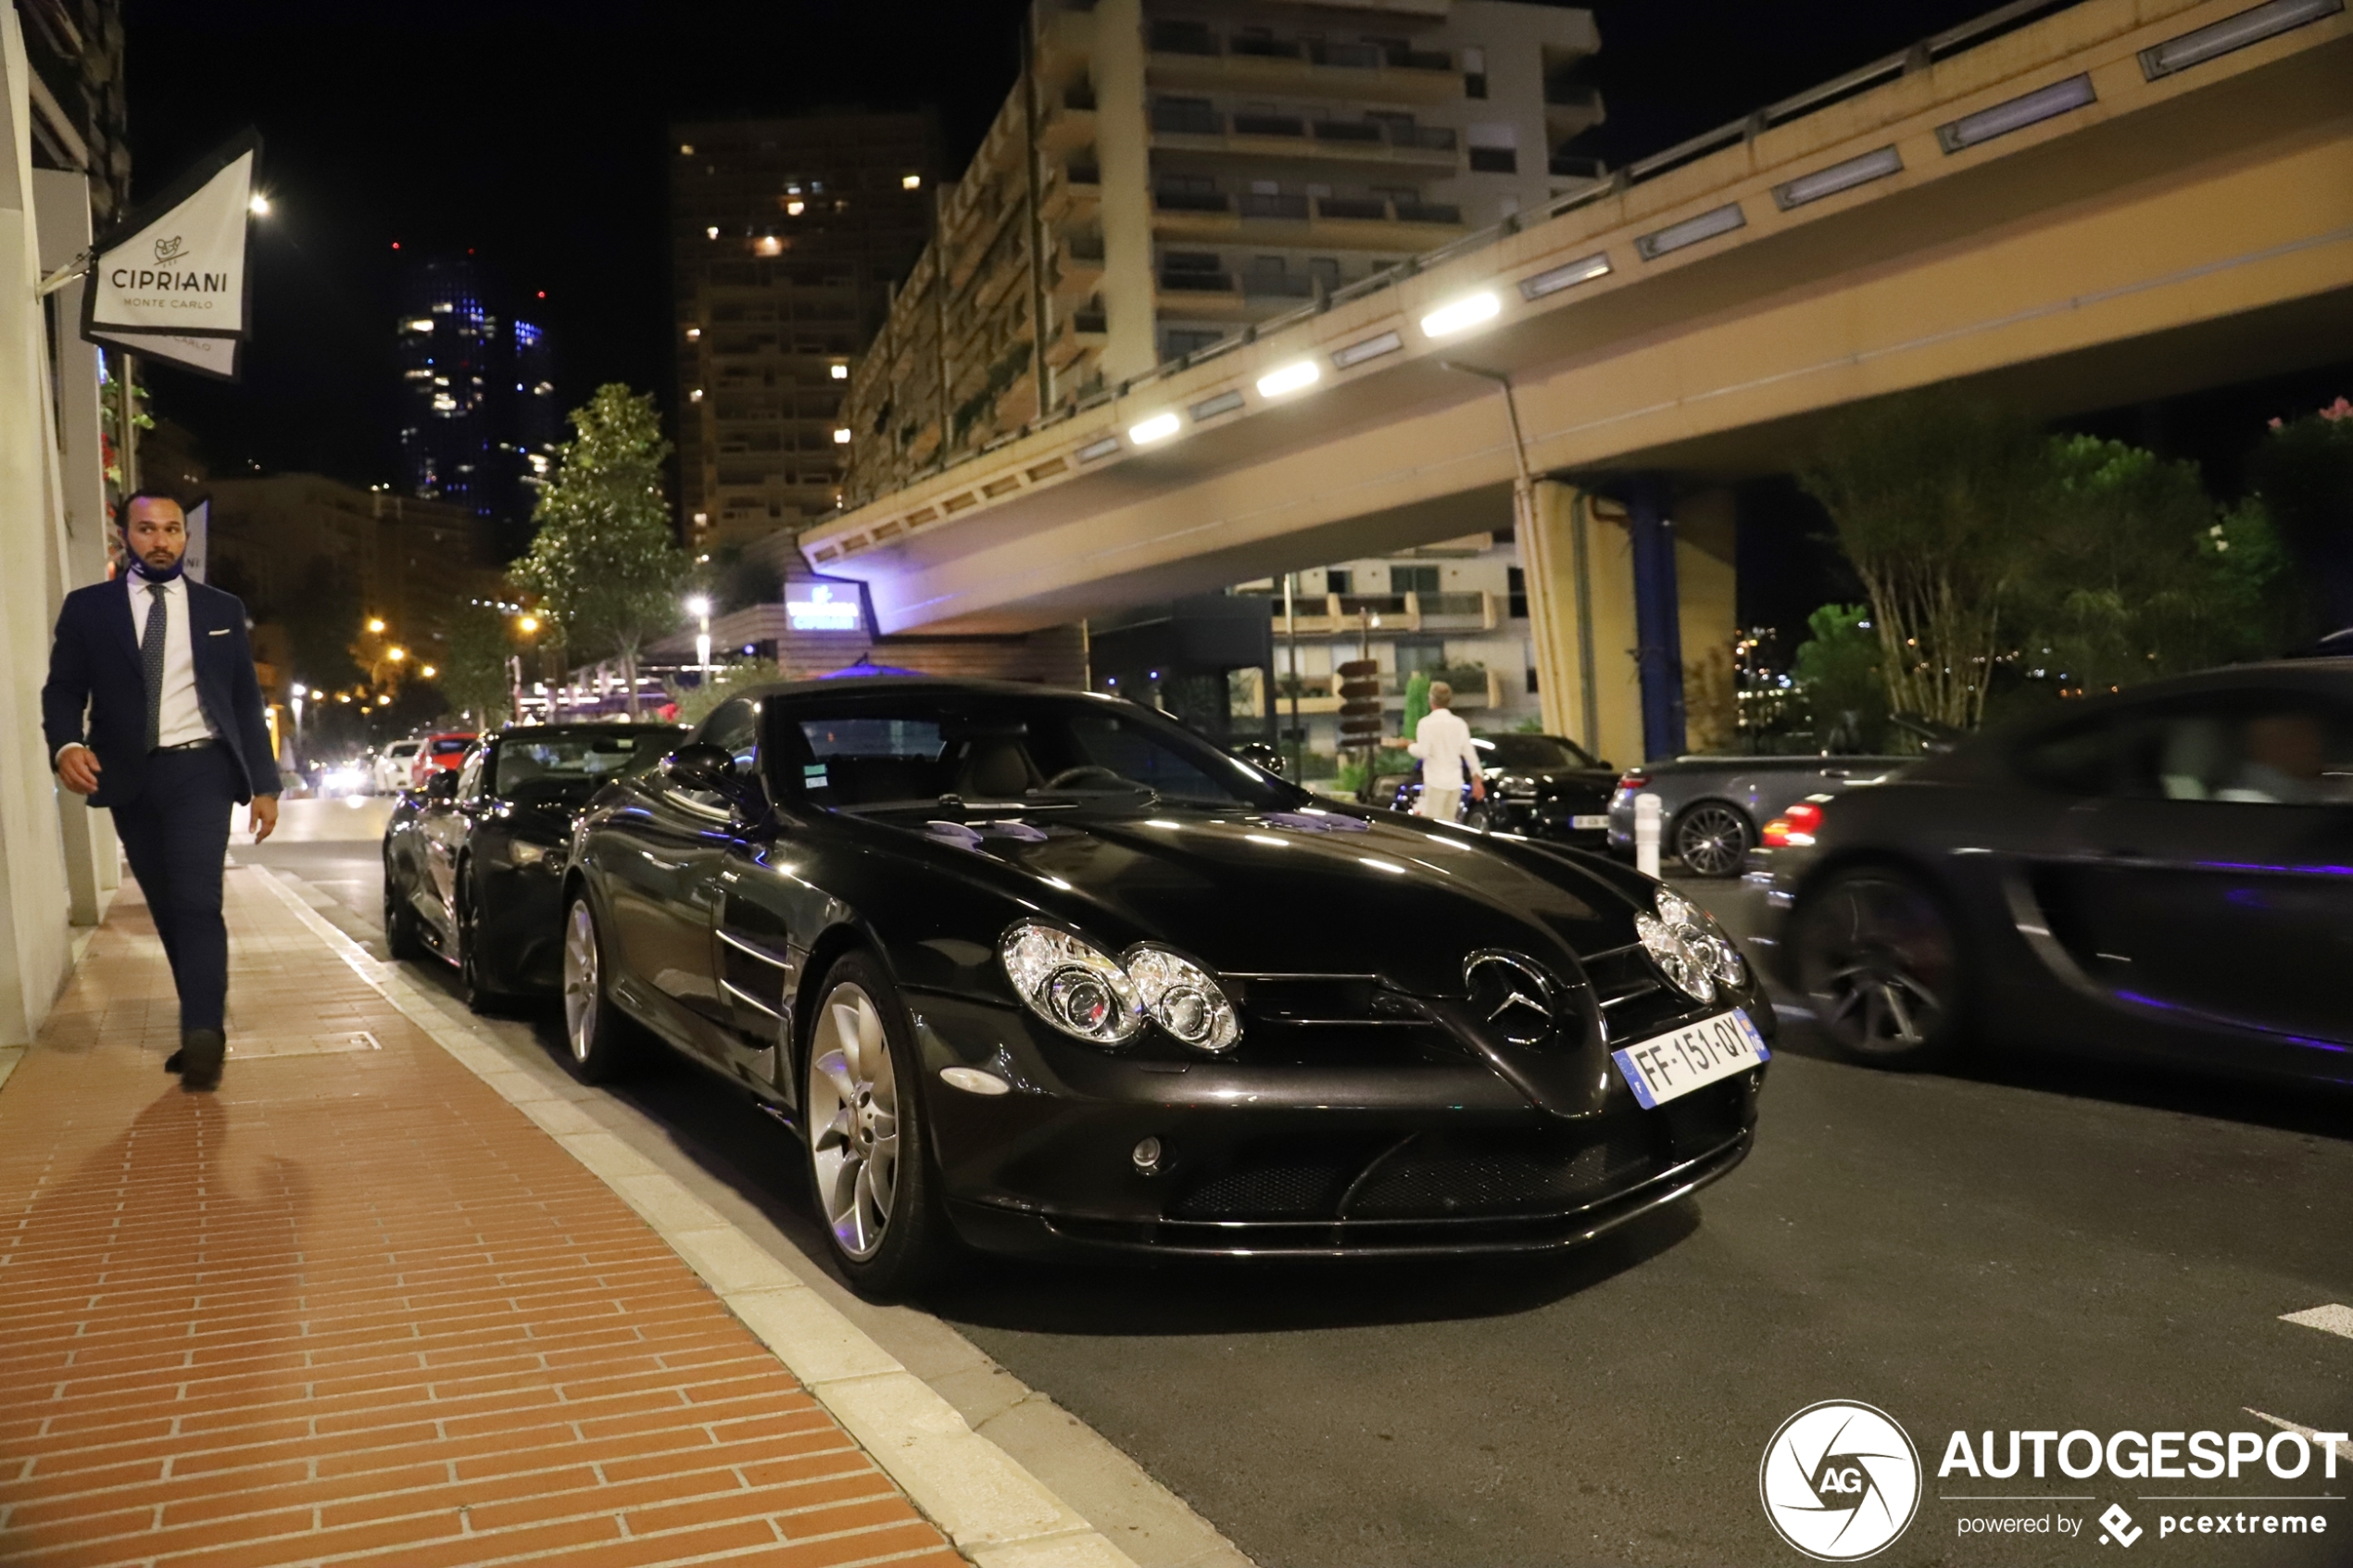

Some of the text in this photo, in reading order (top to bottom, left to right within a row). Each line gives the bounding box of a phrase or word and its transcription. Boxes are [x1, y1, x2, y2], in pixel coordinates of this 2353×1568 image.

[112, 269, 227, 292] CIPRIANI
[123, 298, 213, 309] MONTE CARLO
[1634, 1017, 1748, 1092] FF-151-QY
